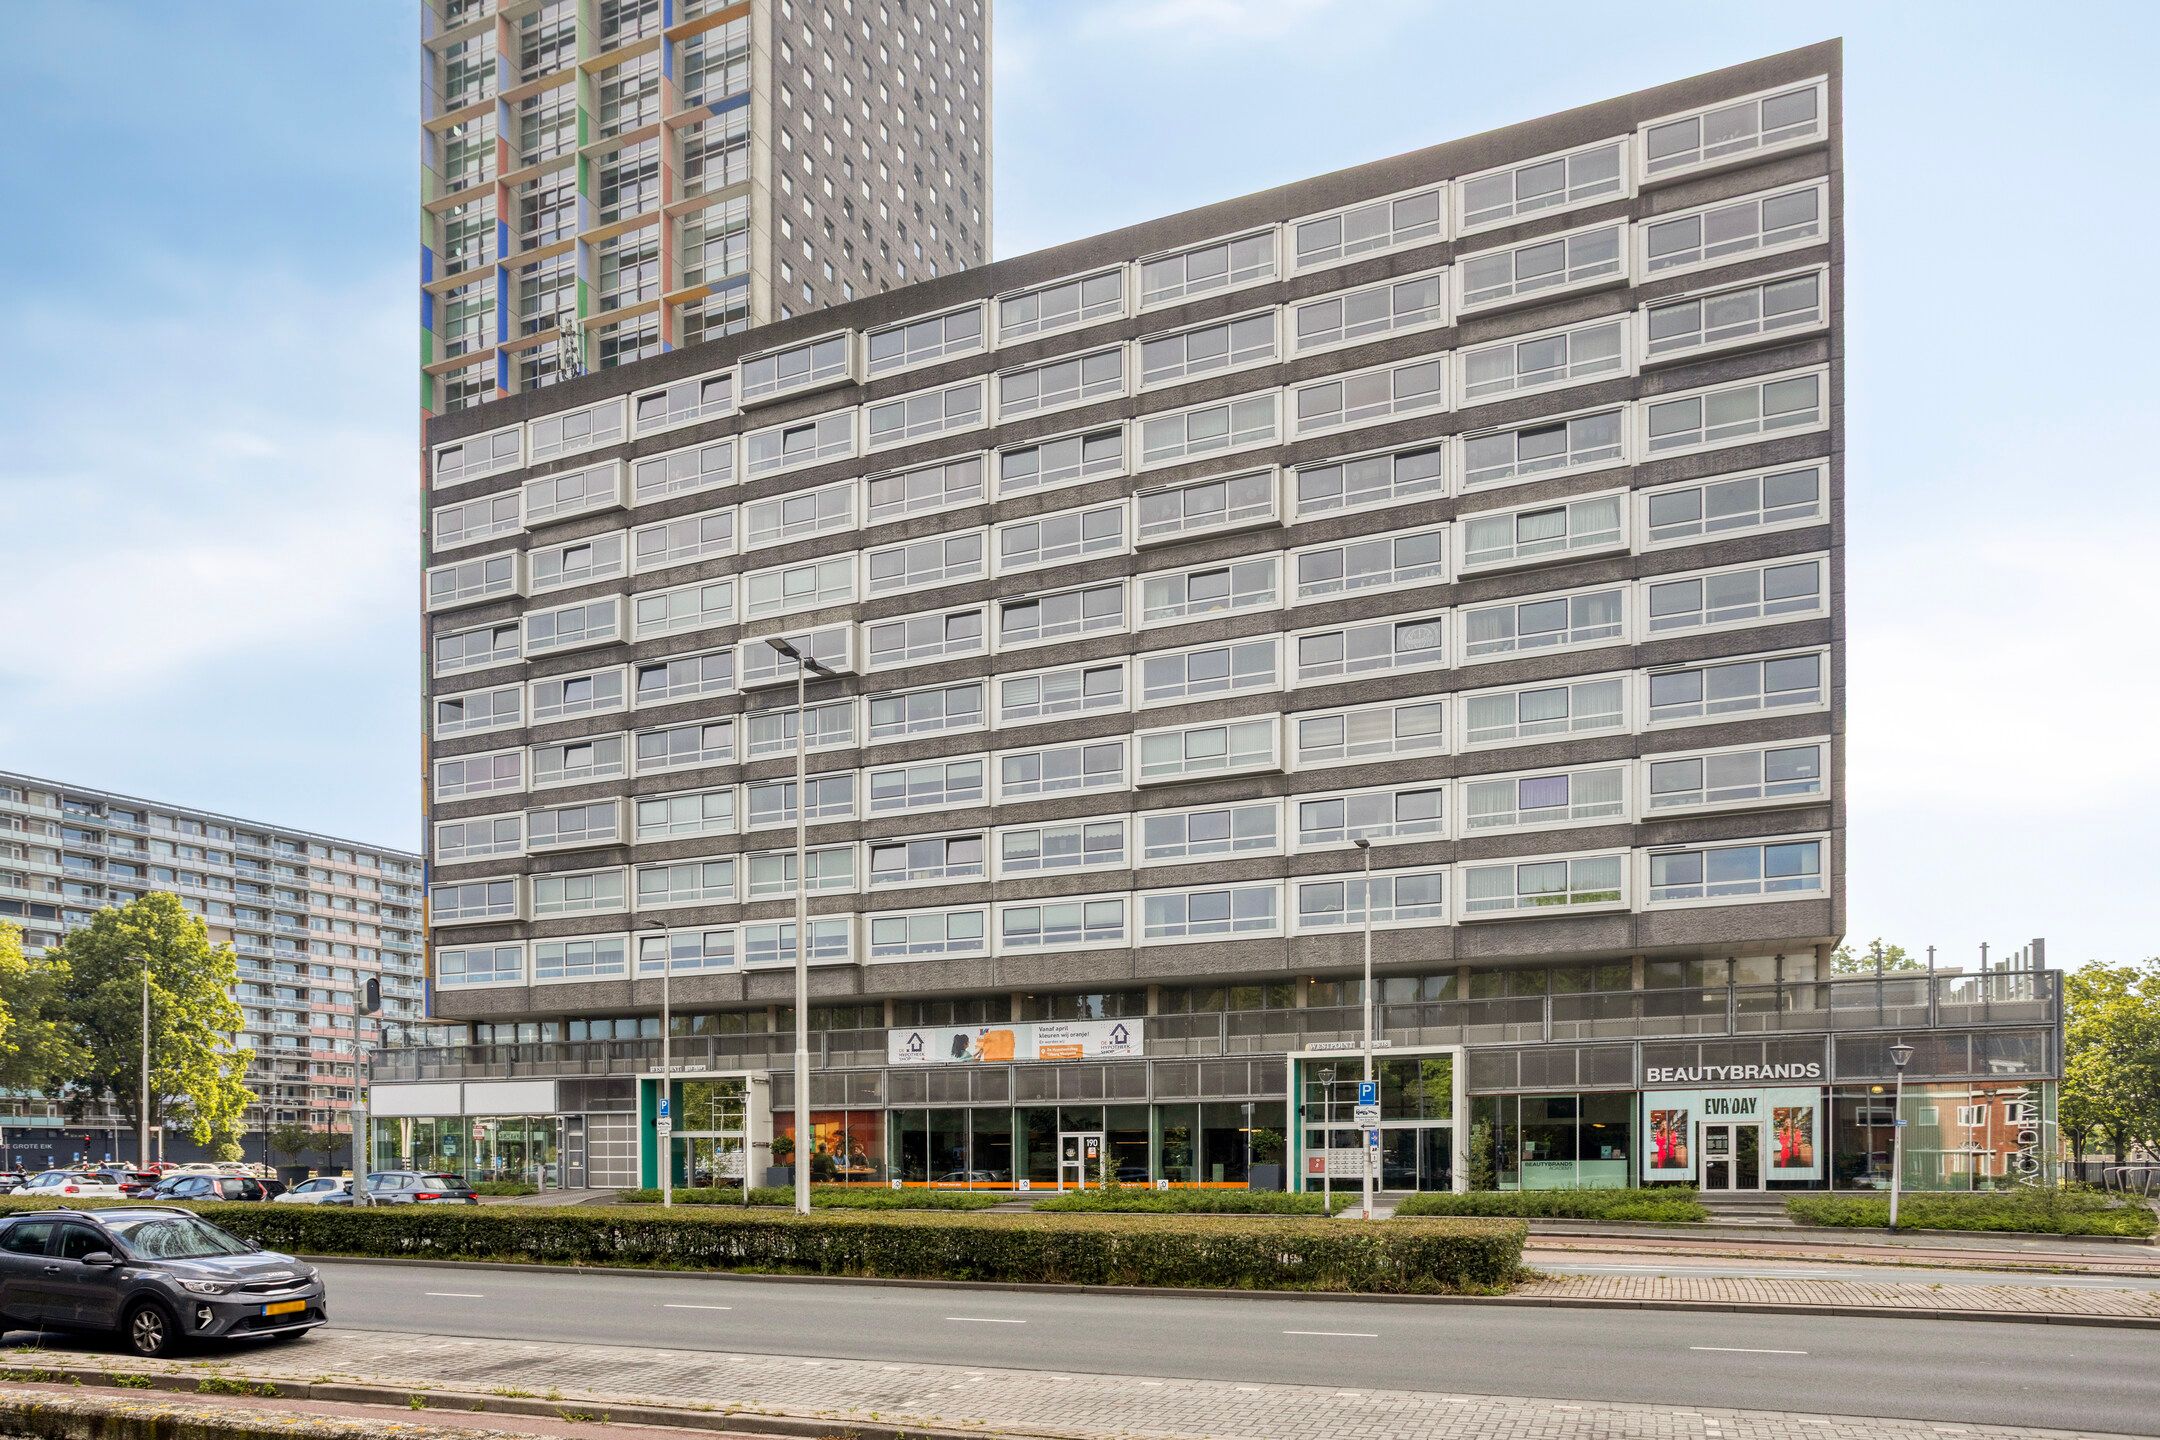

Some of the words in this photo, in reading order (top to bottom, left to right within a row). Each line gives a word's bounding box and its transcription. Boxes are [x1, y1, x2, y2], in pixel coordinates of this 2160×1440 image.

[1310, 1042, 1355, 1051] WESTPOINT
[1647, 1063, 1820, 1082] BEAUTYBRANDS
[1362, 1084, 1371, 1096] P
[662, 1101, 667, 1109] P
[2018, 1086, 2039, 1188] ACADEMY
